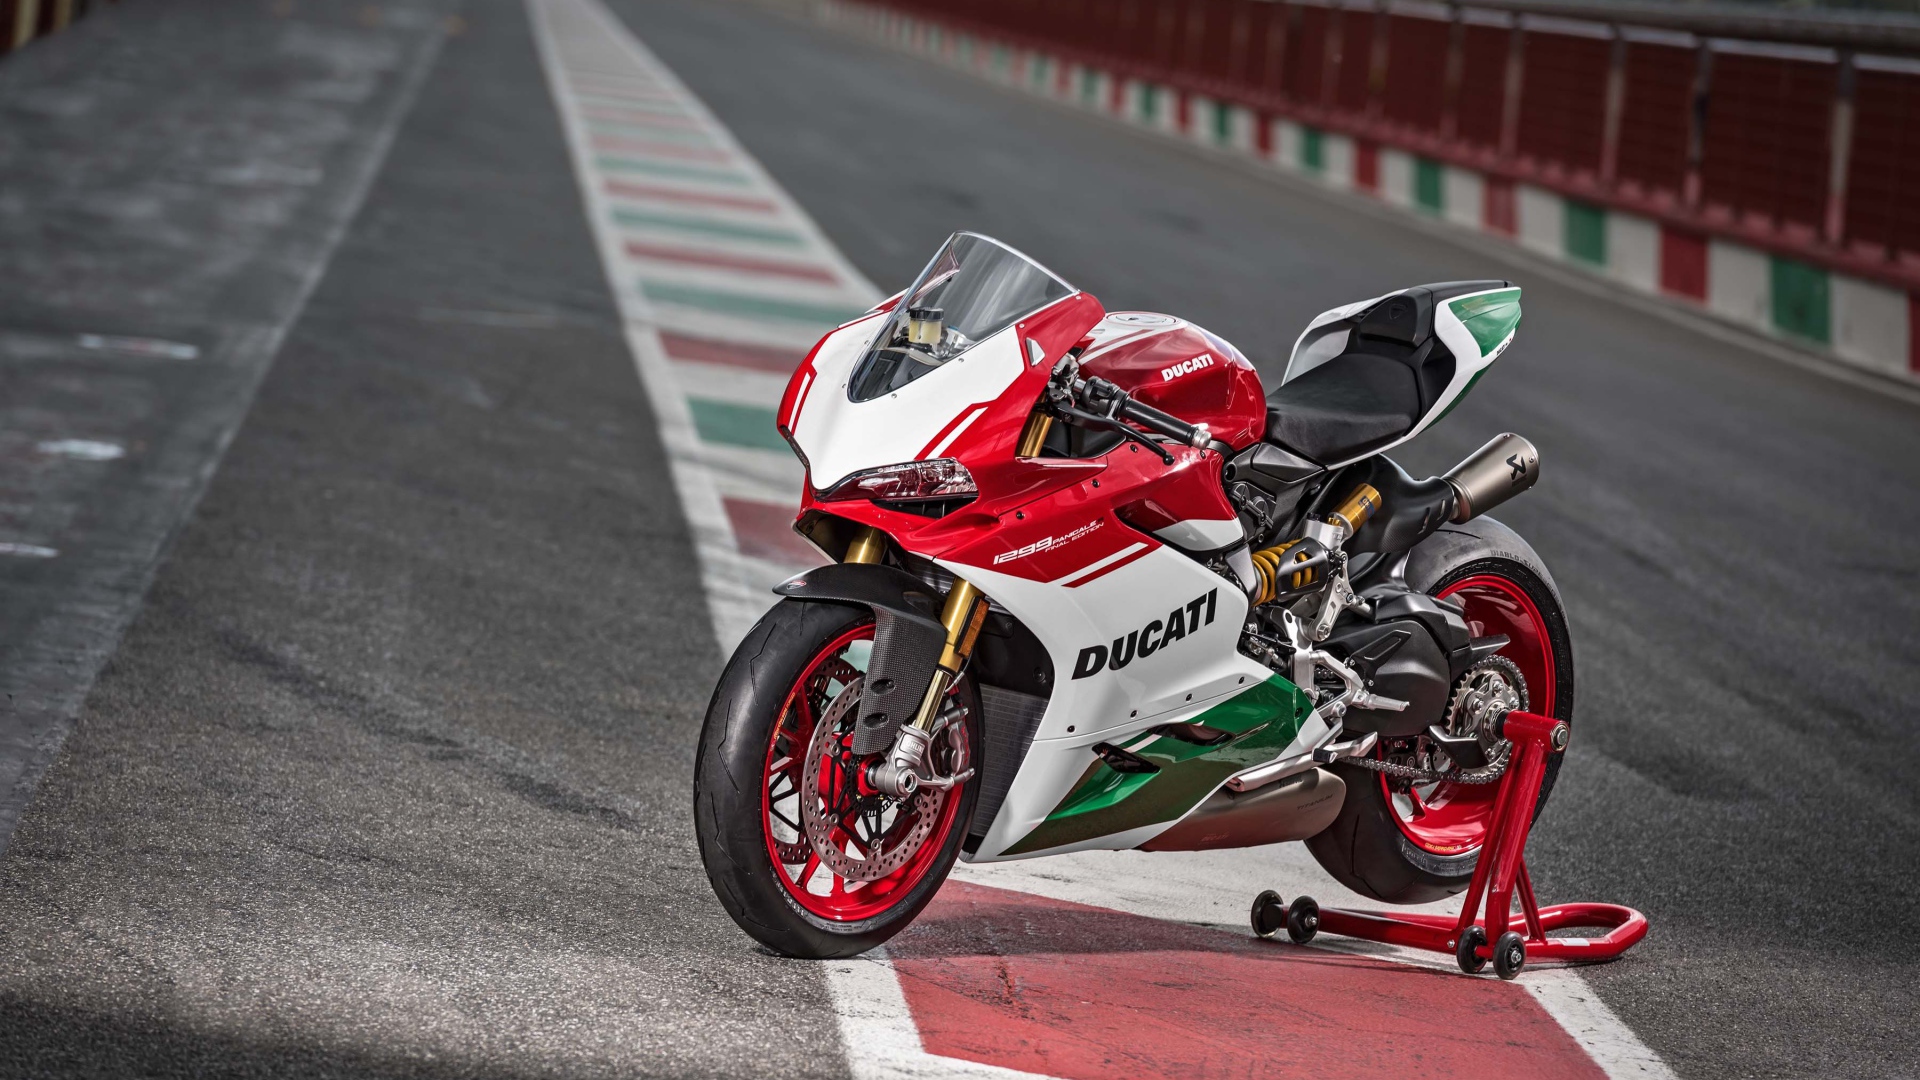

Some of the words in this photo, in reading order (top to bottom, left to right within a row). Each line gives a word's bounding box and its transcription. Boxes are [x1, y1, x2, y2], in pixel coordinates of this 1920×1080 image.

[1162, 354, 1213, 381] DUCATI
[993, 536, 1053, 565] 1299
[1052, 520, 1097, 545] PANIGALE
[1045, 541, 1070, 553] FINAL
[1072, 522, 1104, 541] EDITION
[1072, 588, 1217, 680] DUCATI
[1297, 794, 1333, 810] TITANIUM
